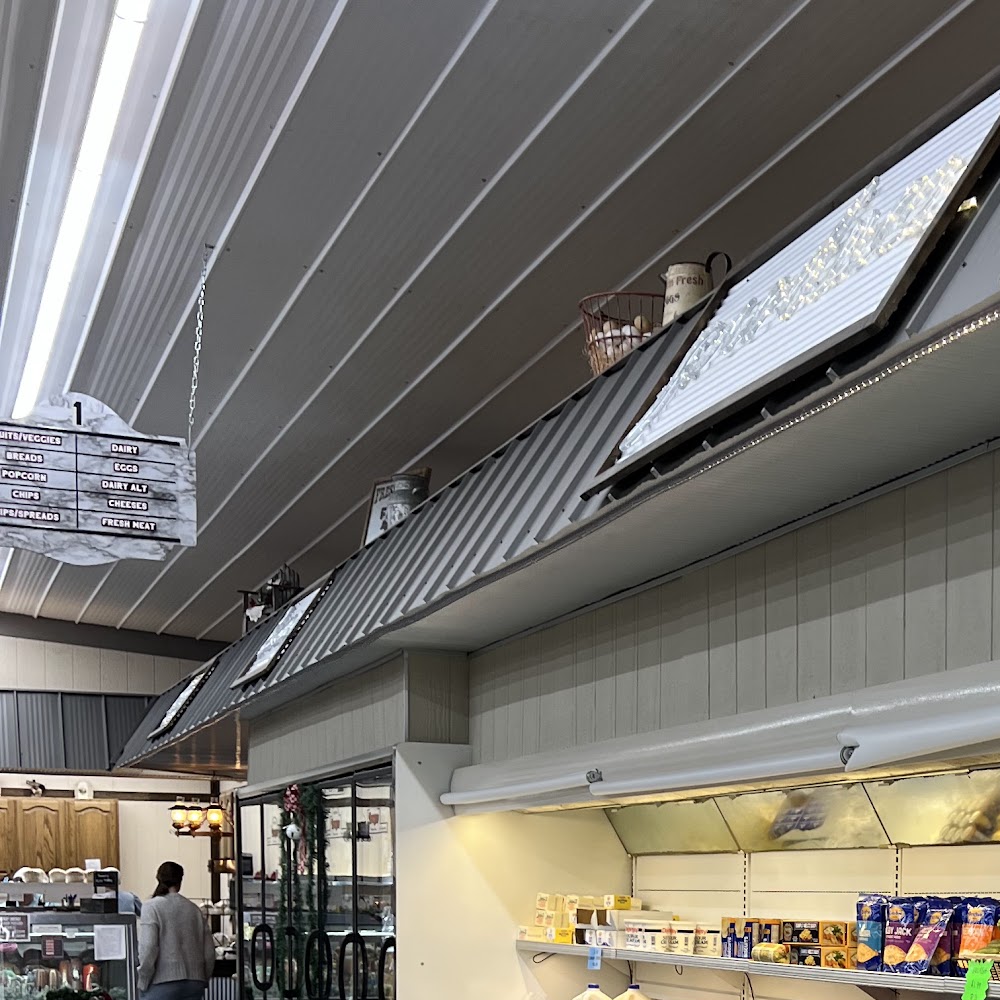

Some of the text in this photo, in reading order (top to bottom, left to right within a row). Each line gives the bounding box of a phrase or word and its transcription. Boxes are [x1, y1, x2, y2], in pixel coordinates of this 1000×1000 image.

[676, 275, 704, 286] Fresh
[73, 401, 82, 426] 1
[111, 443, 139, 455] DAIRY
[6, 451, 44, 463] BREADS
[114, 462, 139, 473] EGGS
[1, 469, 48, 482] POPCORN
[101, 480, 148, 493] DAIRY ALT
[12, 490, 40, 500] CHIPS
[108, 499, 148, 510] CHEESES
[101, 518, 156, 532] FRESH MEAT
